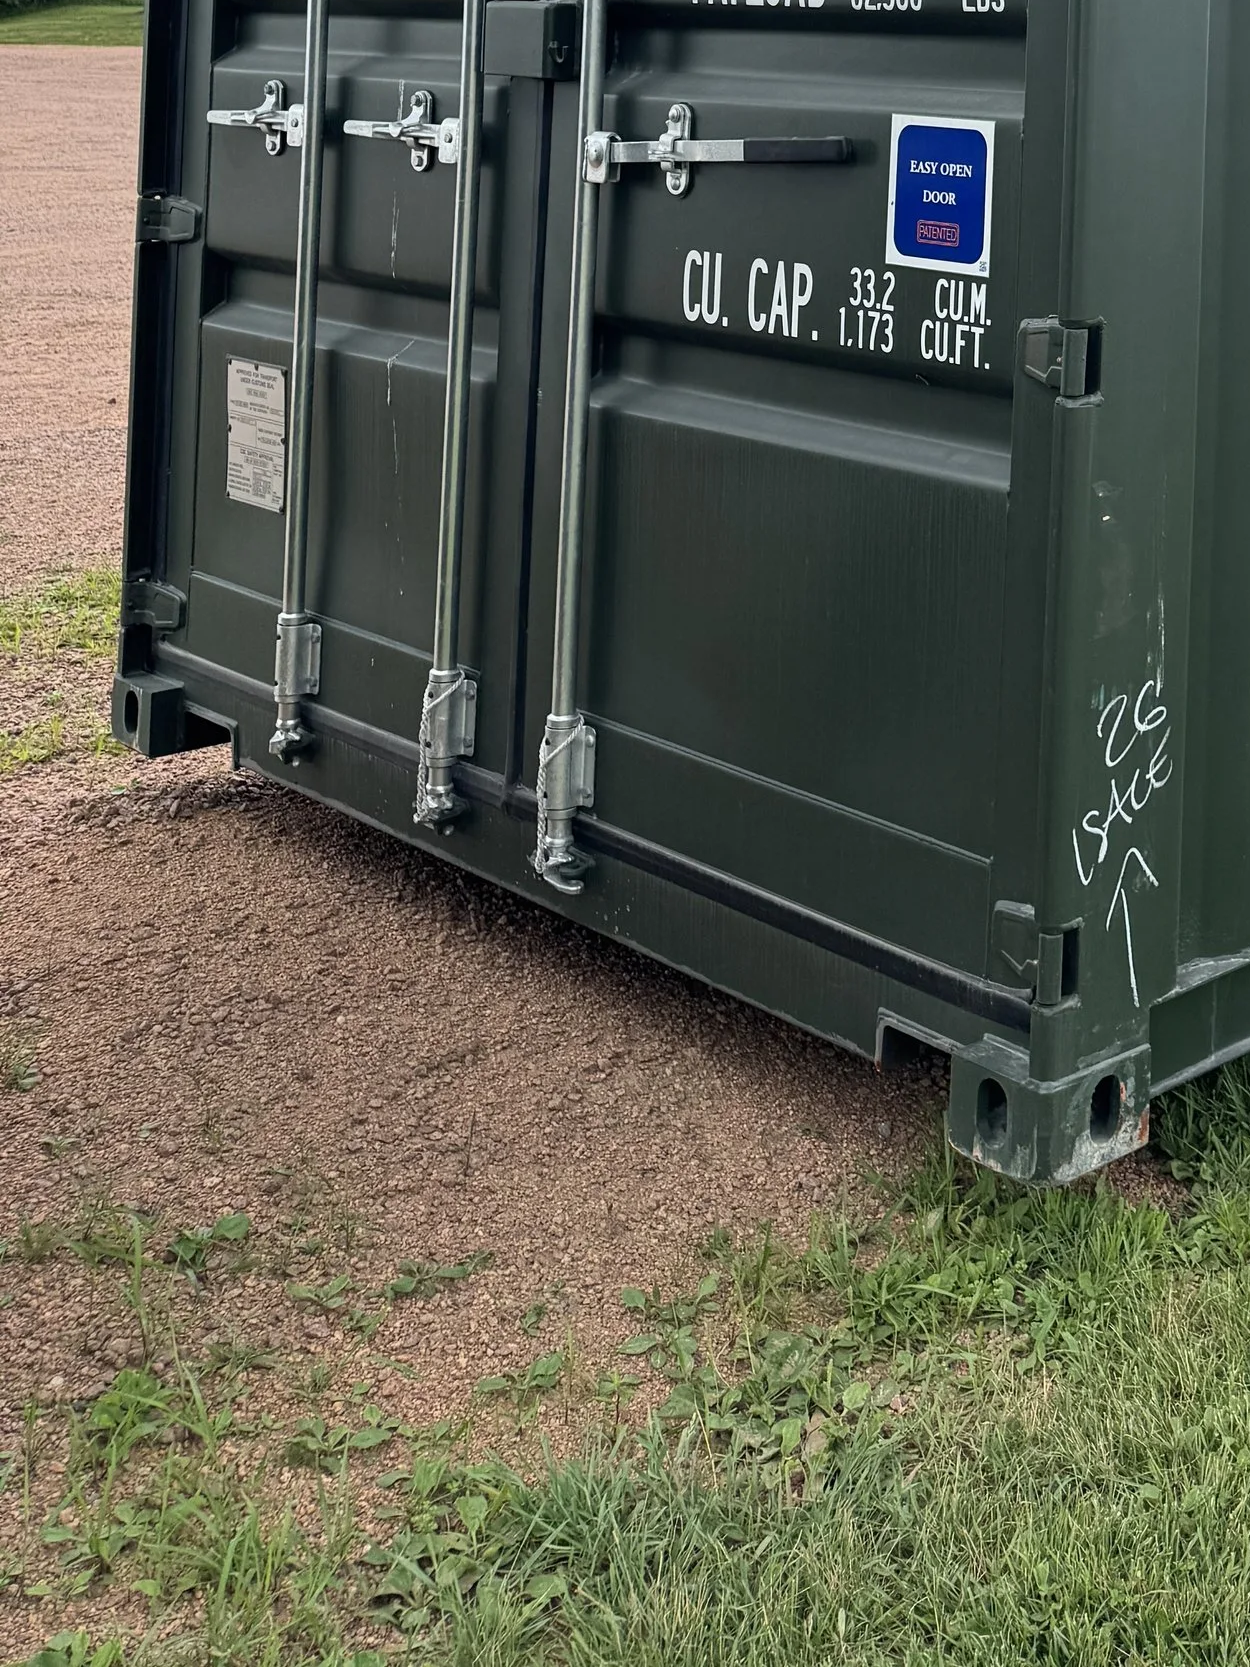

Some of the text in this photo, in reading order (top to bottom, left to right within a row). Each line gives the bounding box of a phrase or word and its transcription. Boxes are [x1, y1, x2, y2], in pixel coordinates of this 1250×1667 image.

[910, 160, 973, 178] EASY OPEN
[923, 189, 957, 205] DOOR
[919, 224, 957, 242] PATENTED
[683, 249, 992, 341] CU. CAP. 33.2 CU.M.
[839, 306, 991, 370] 1,173 CU.FT.
